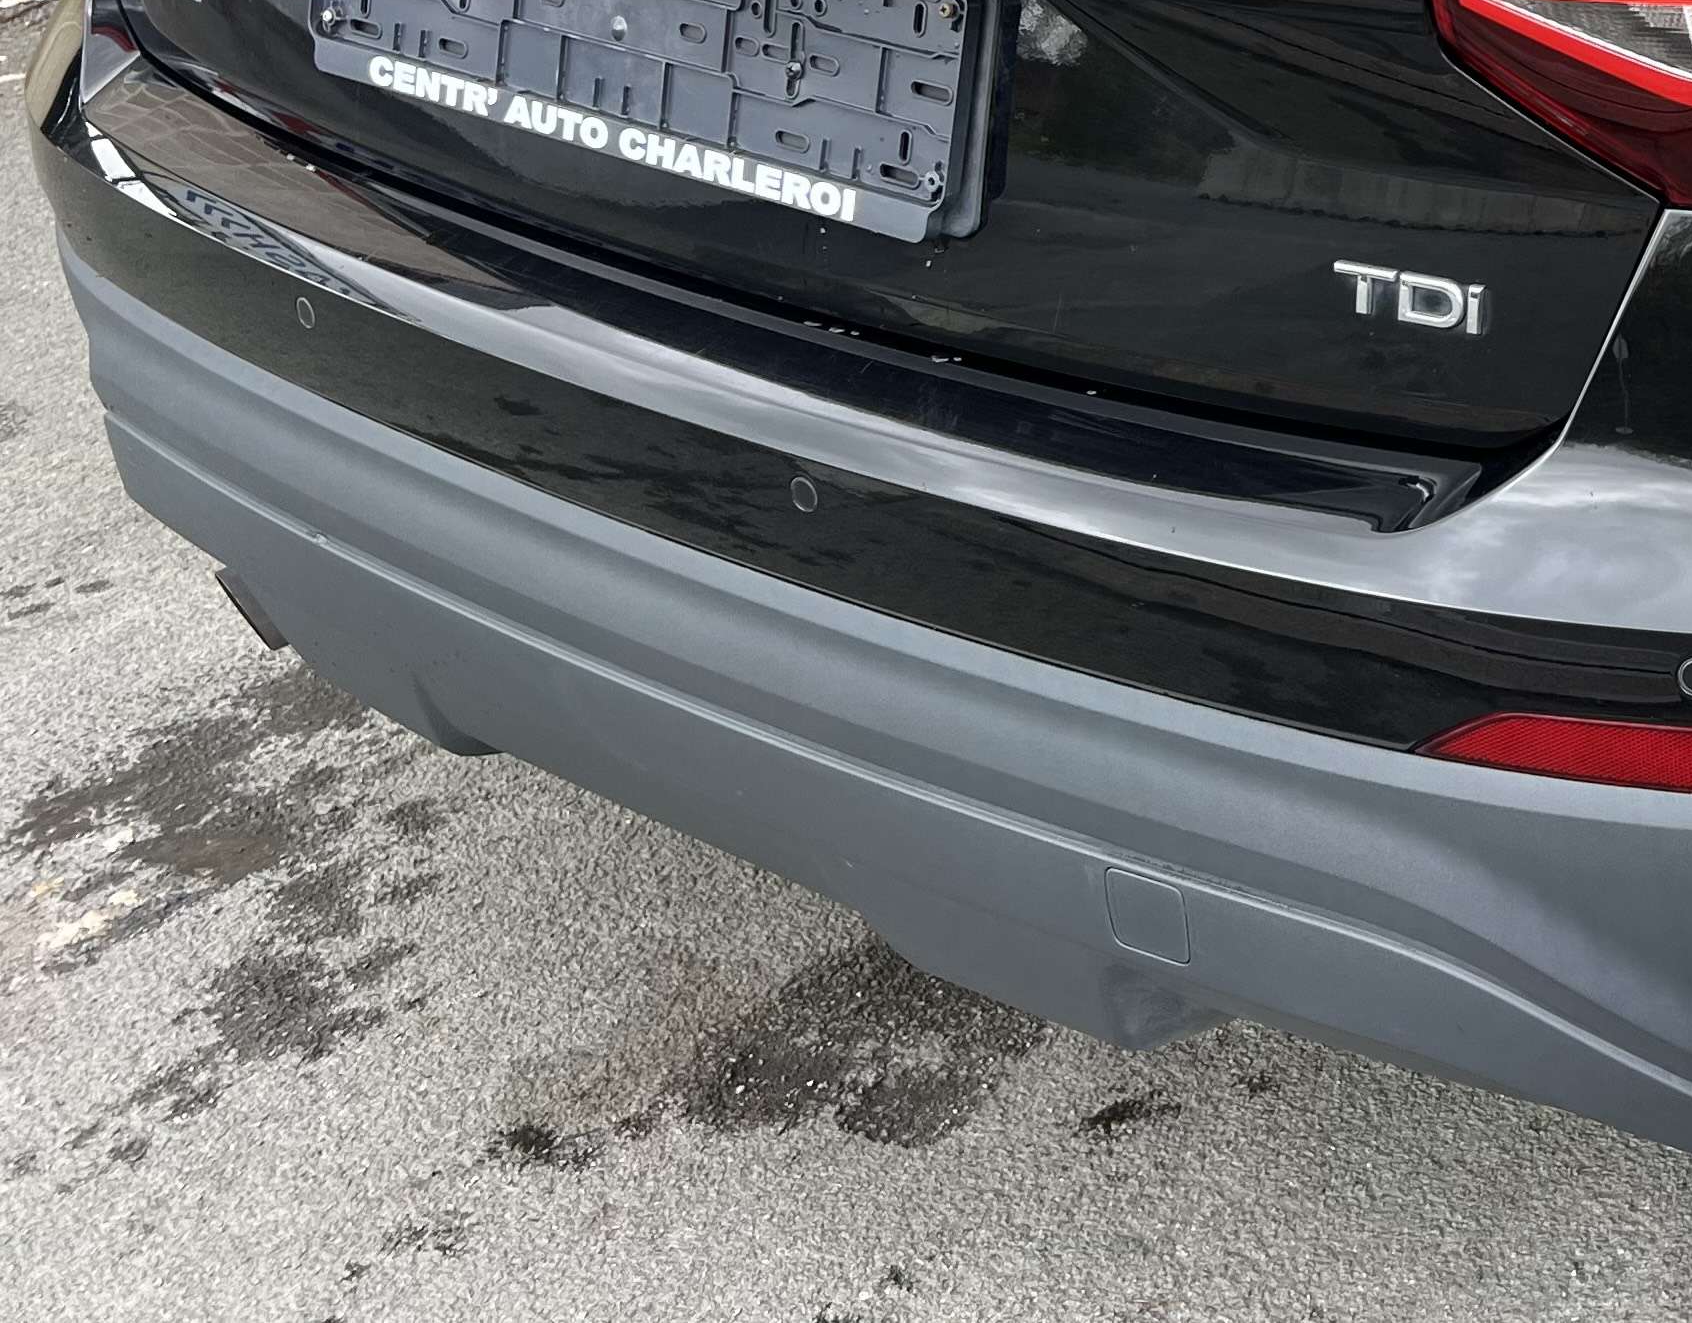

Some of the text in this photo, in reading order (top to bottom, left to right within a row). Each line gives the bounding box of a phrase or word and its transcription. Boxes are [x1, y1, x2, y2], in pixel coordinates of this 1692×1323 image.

[368, 55, 858, 222] CENTR' AUTO CHARLEROI
